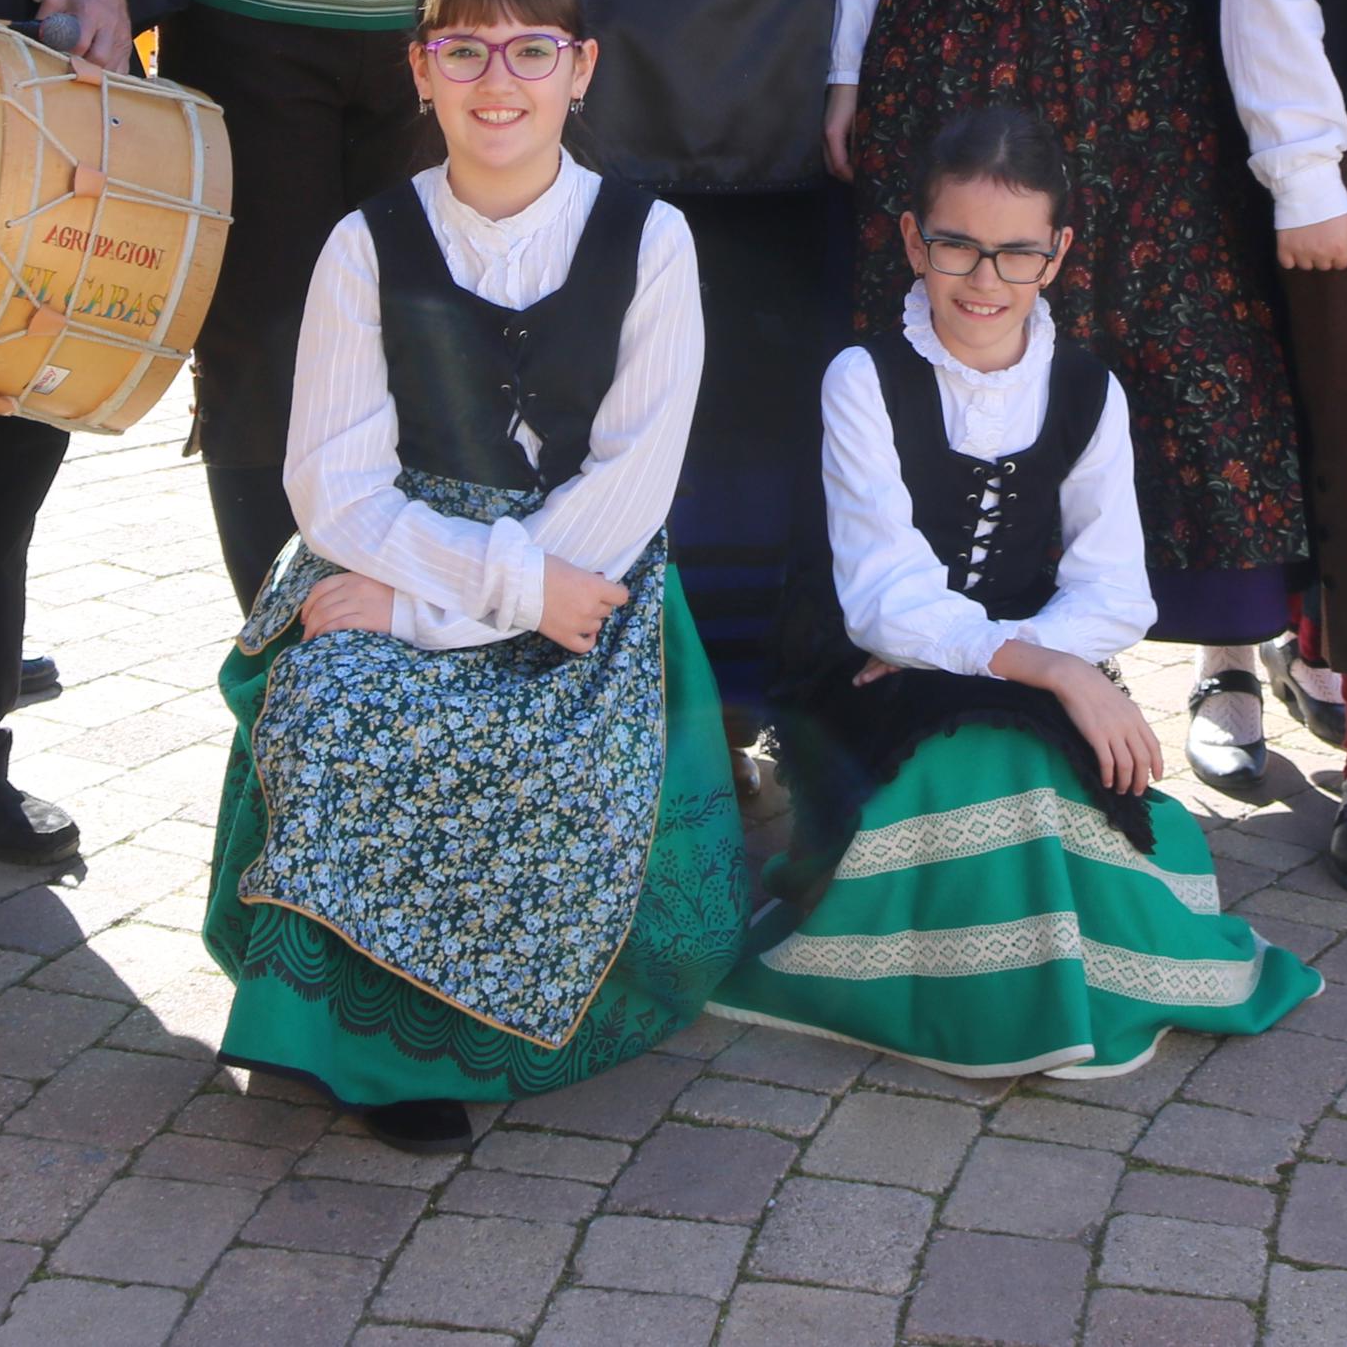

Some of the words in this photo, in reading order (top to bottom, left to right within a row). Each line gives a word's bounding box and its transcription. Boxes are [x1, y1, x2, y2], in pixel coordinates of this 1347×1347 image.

[42, 223, 167, 270] AGRUPACION
[12, 264, 58, 305] EL
[64, 276, 168, 327] CABAS
